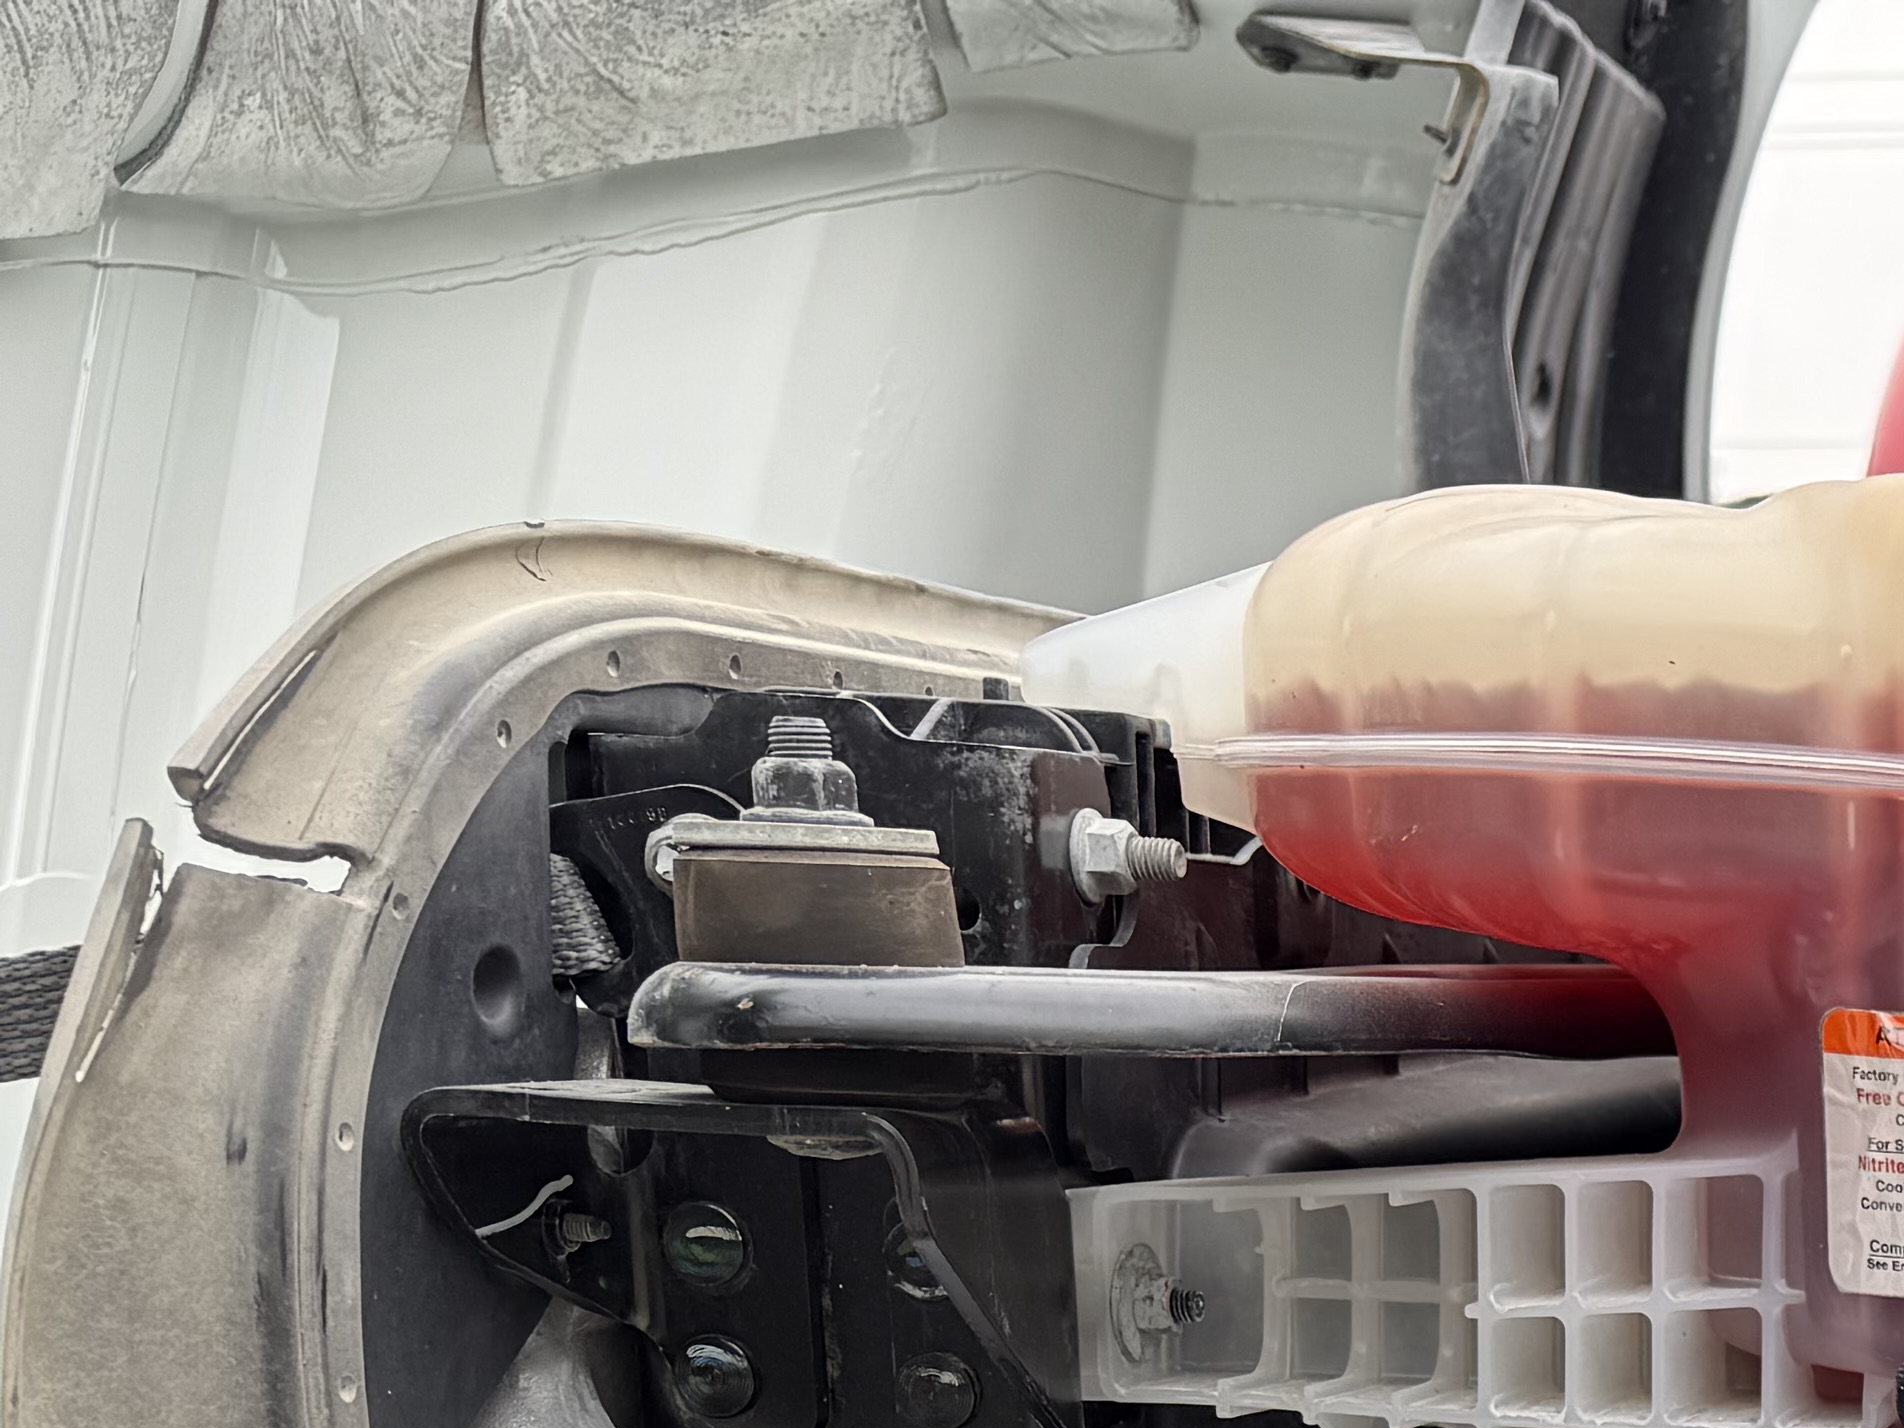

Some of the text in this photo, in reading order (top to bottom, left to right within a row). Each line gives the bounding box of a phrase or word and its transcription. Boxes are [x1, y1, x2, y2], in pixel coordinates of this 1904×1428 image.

[1852, 1066, 1899, 1086] Factory
[1856, 1088, 1892, 1105] Free
[1867, 1137, 1890, 1152] For
[1867, 1258, 1889, 1271] See
